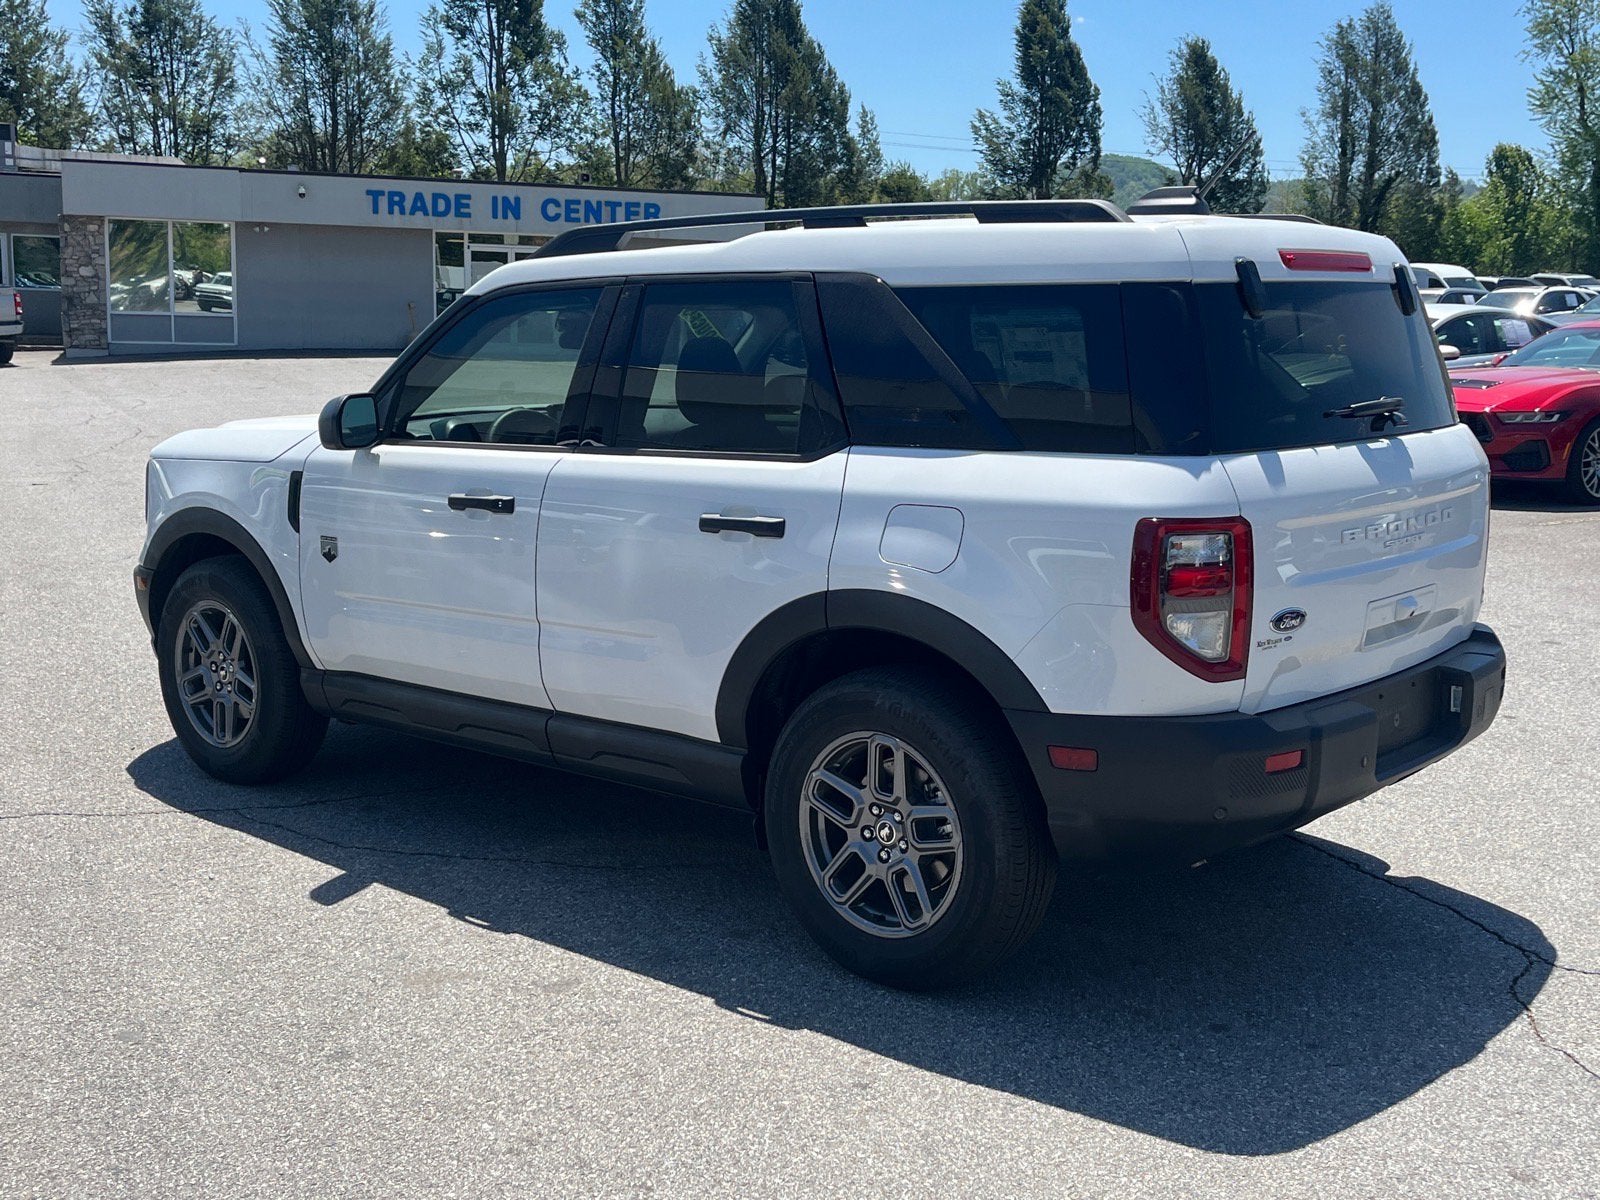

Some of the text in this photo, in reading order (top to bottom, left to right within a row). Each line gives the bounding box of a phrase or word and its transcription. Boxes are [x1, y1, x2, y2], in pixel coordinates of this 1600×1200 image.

[366, 189, 661, 224] TRADE IN CENTER
[1341, 506, 1454, 544] BRONCO
[1280, 612, 1302, 629] Ford
